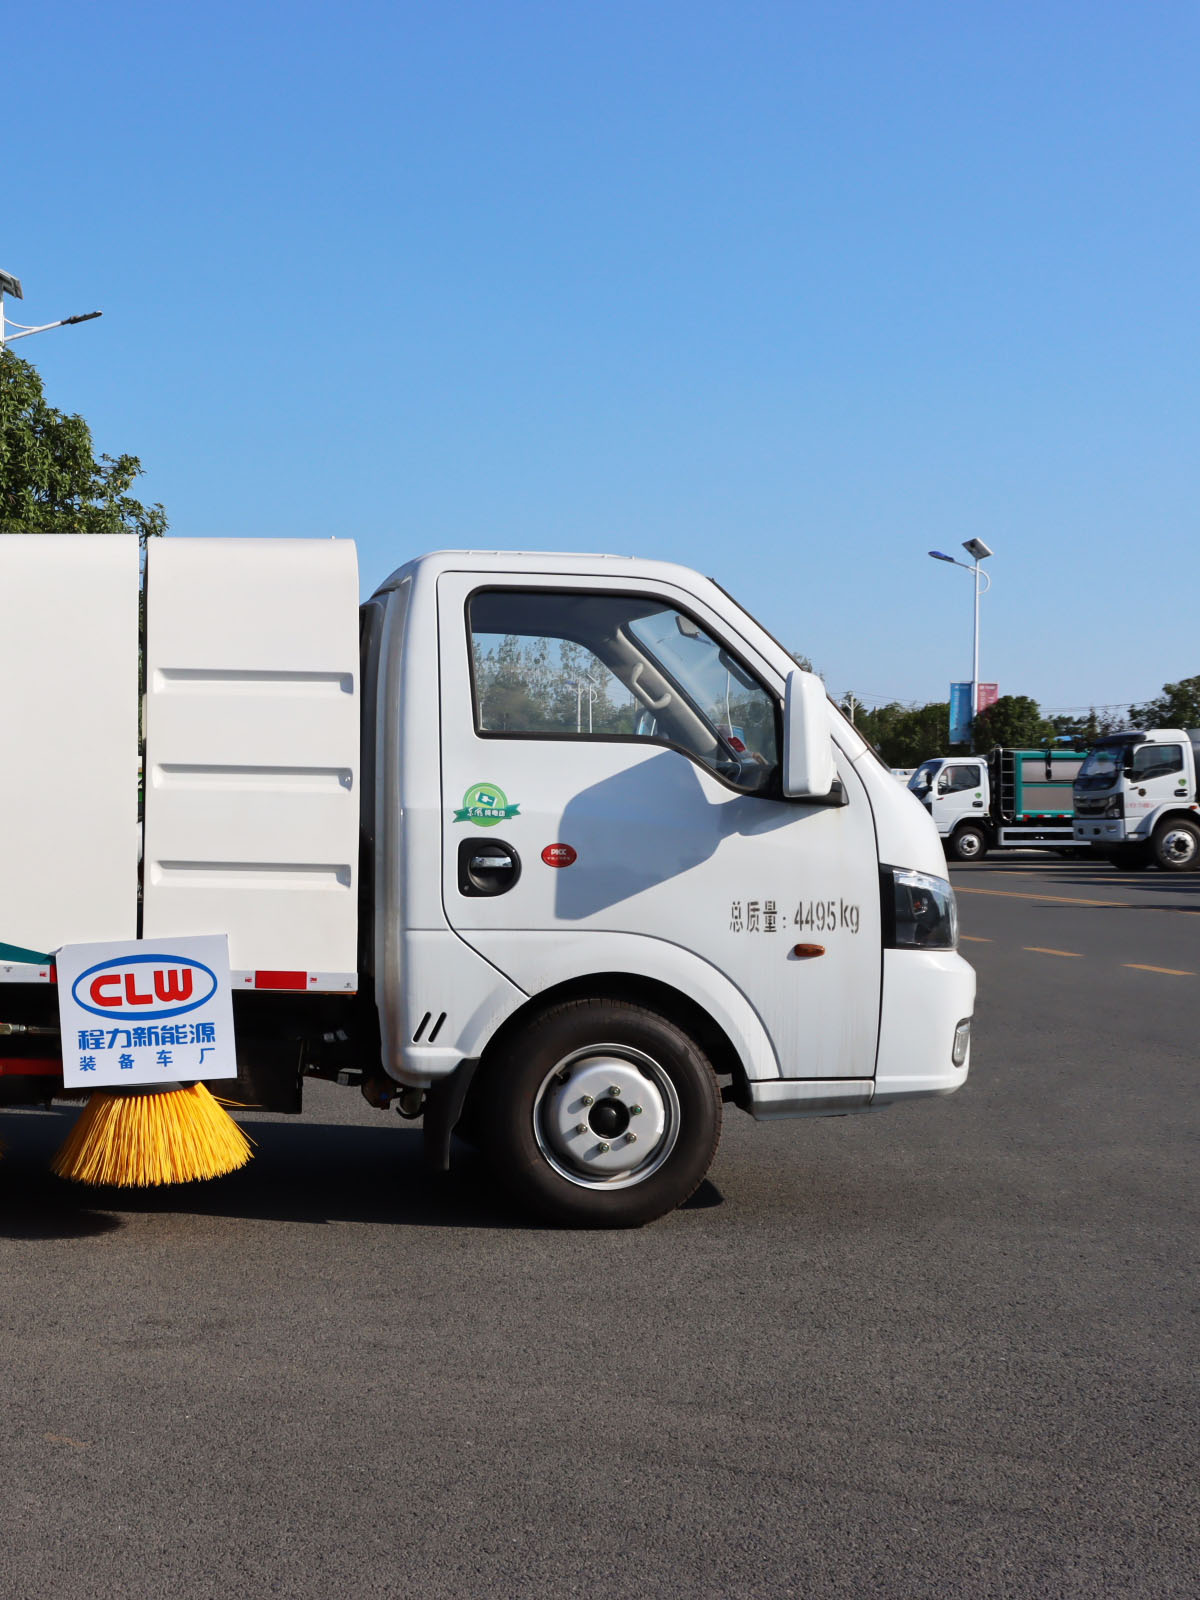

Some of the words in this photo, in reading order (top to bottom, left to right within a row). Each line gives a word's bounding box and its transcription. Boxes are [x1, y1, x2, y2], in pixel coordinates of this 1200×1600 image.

[90, 969, 193, 1007] CLW
[77, 1022, 216, 1051] 程力新能源
